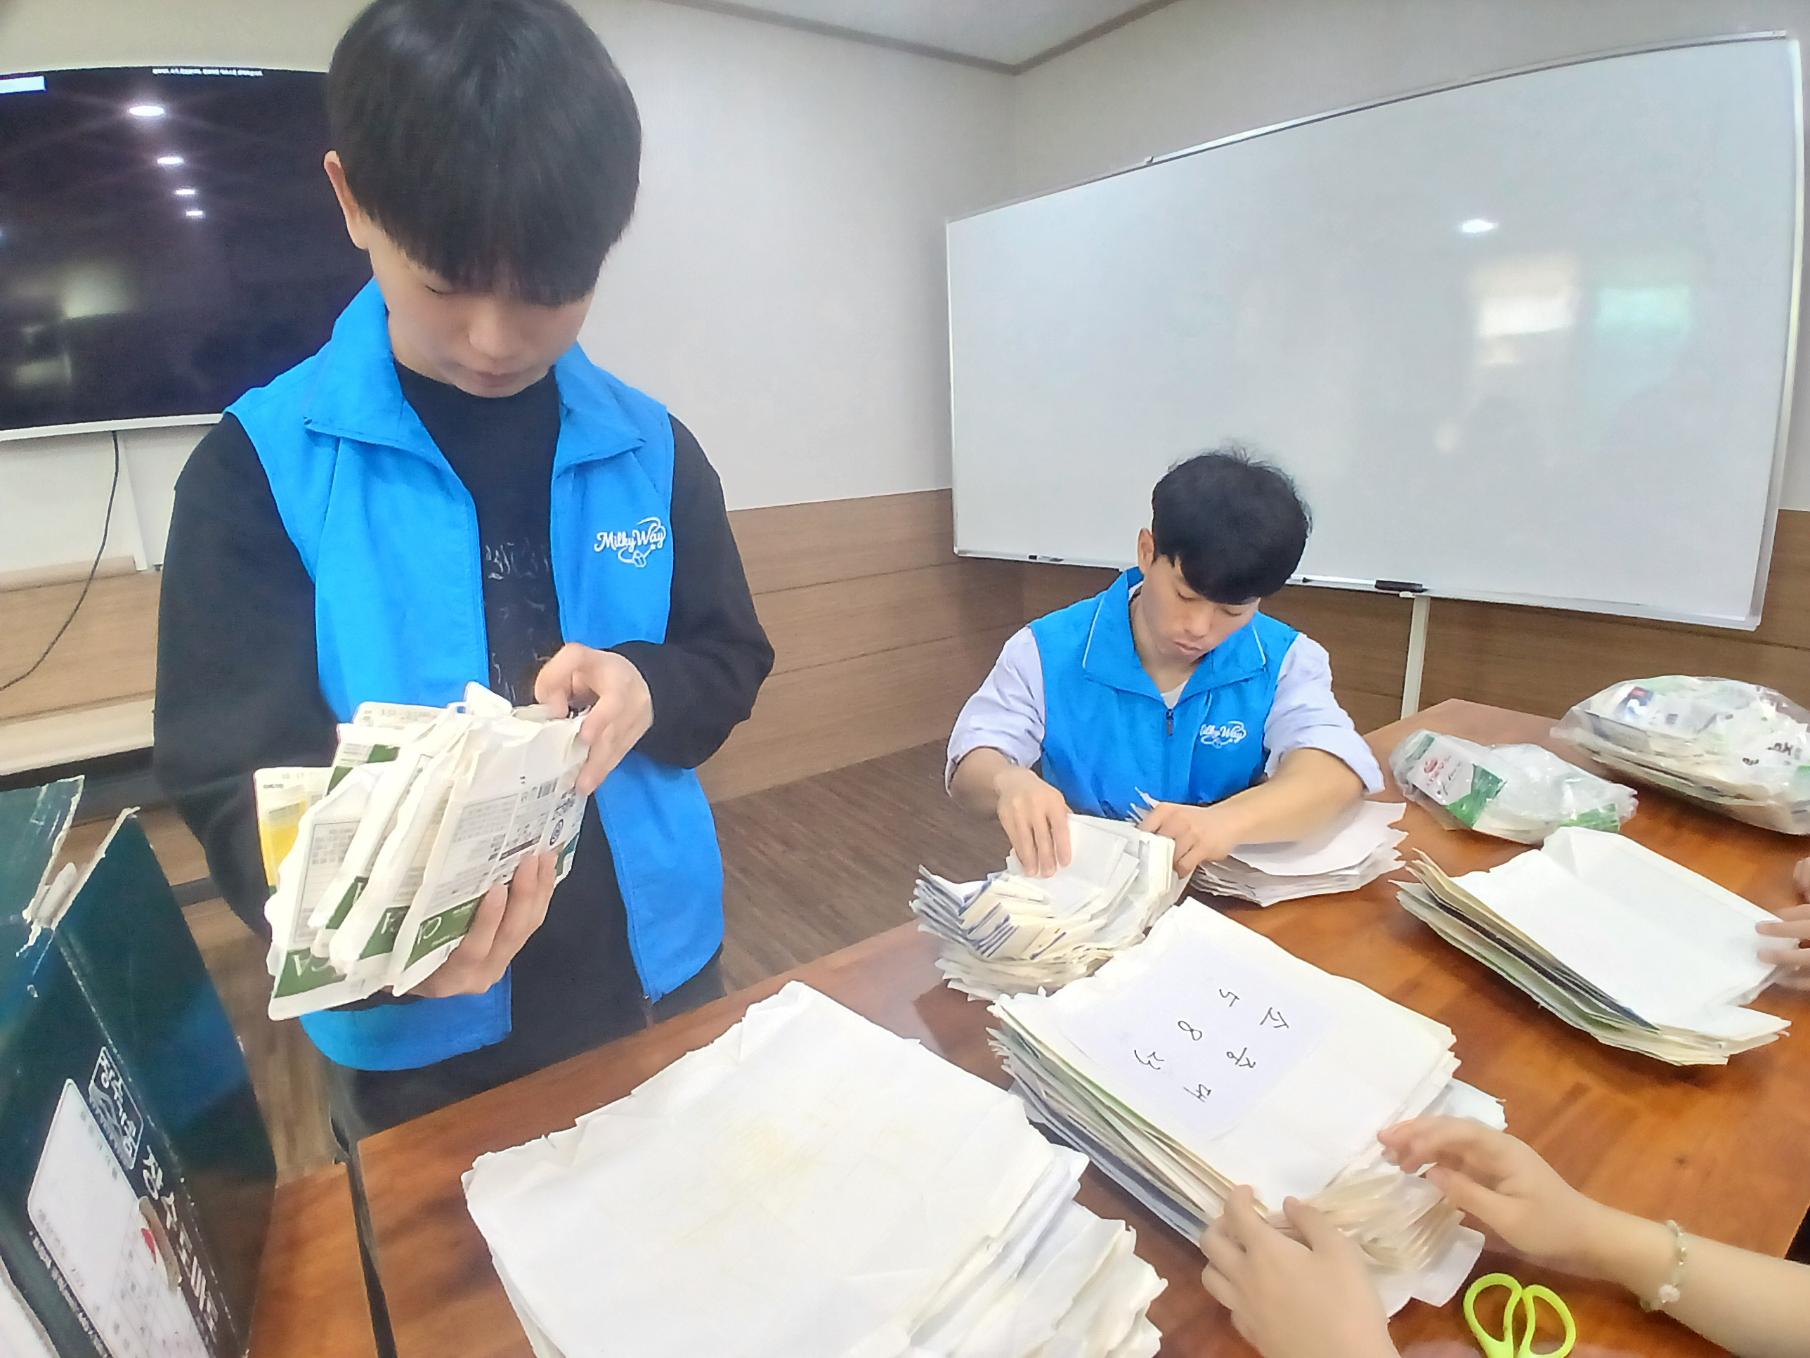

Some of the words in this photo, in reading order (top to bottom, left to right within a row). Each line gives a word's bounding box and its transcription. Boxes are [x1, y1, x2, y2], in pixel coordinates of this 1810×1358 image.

[594, 530, 635, 553] Milky
[632, 518, 667, 549] Way
[1218, 988, 1240, 1008] 5
[1259, 1006, 1290, 1029] 소
[1177, 1020, 1203, 1042] 8
[1225, 1046, 1257, 1069] 중
[1183, 1083, 1212, 1103] 대
